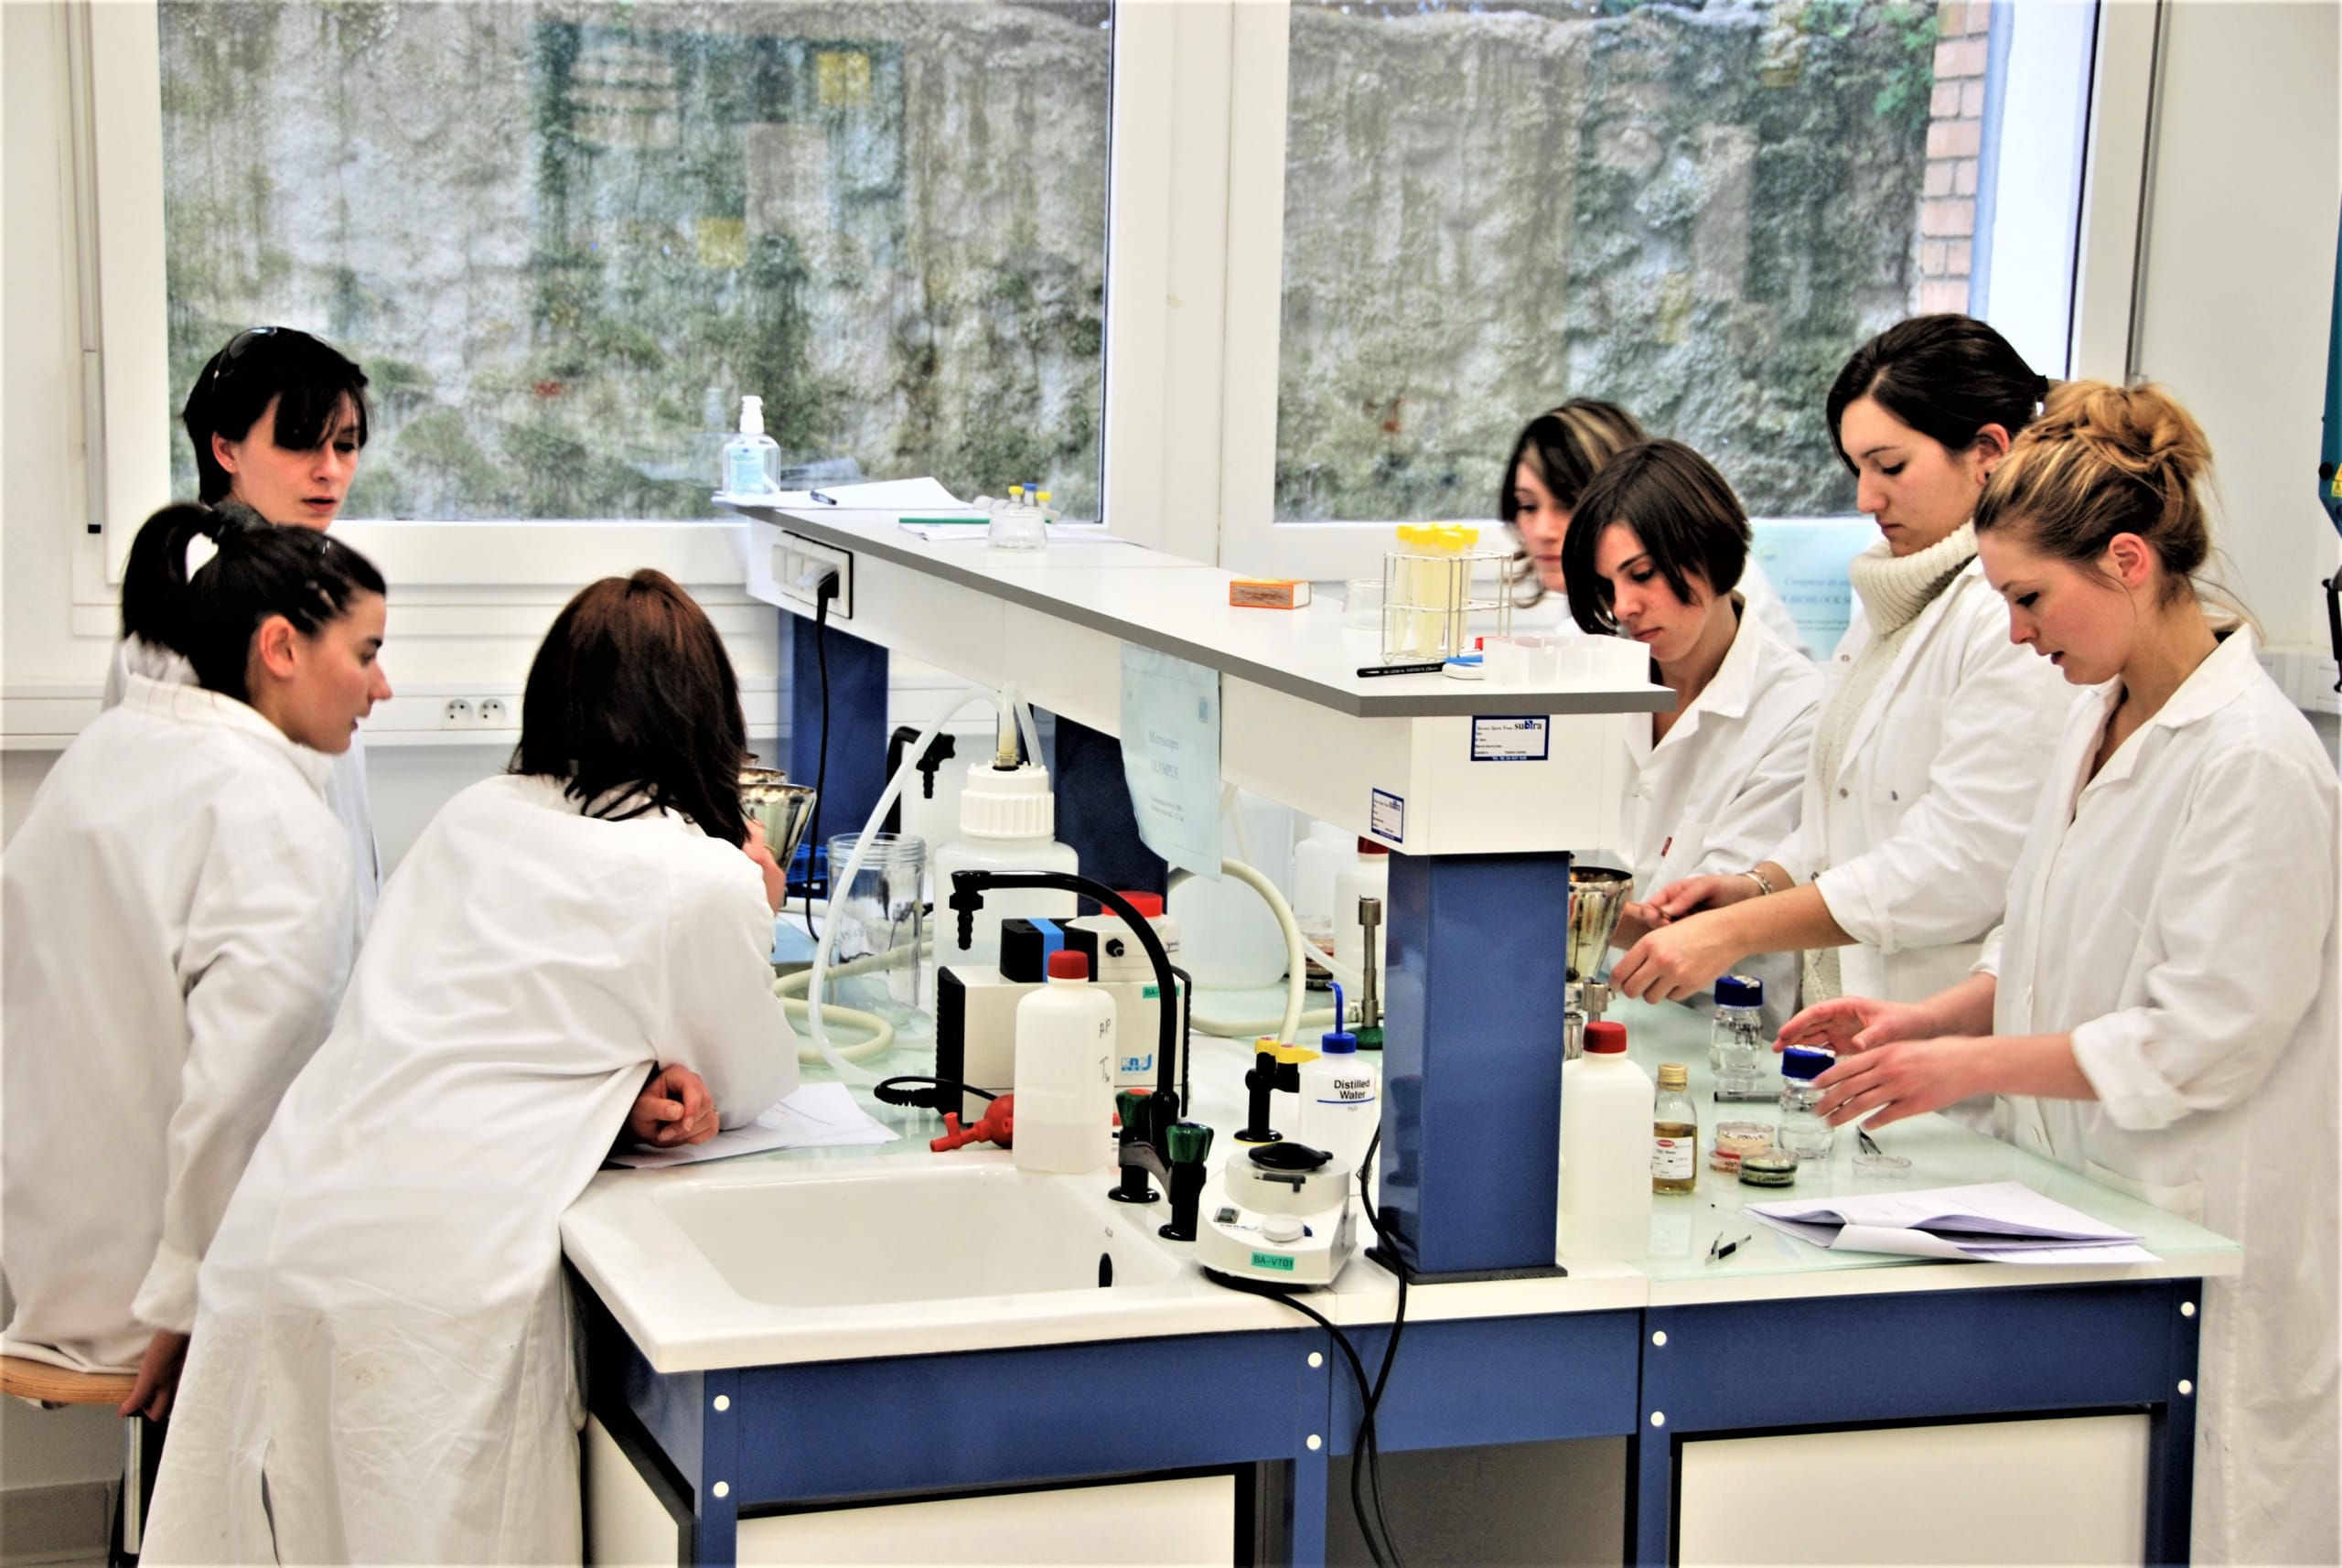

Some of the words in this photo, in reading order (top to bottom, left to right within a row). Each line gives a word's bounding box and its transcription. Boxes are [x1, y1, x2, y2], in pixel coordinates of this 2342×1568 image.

[1334, 1079, 1370, 1090] Distilled
[1339, 1090, 1367, 1100] Water
[1252, 1254, 1294, 1268] BA-VT01
